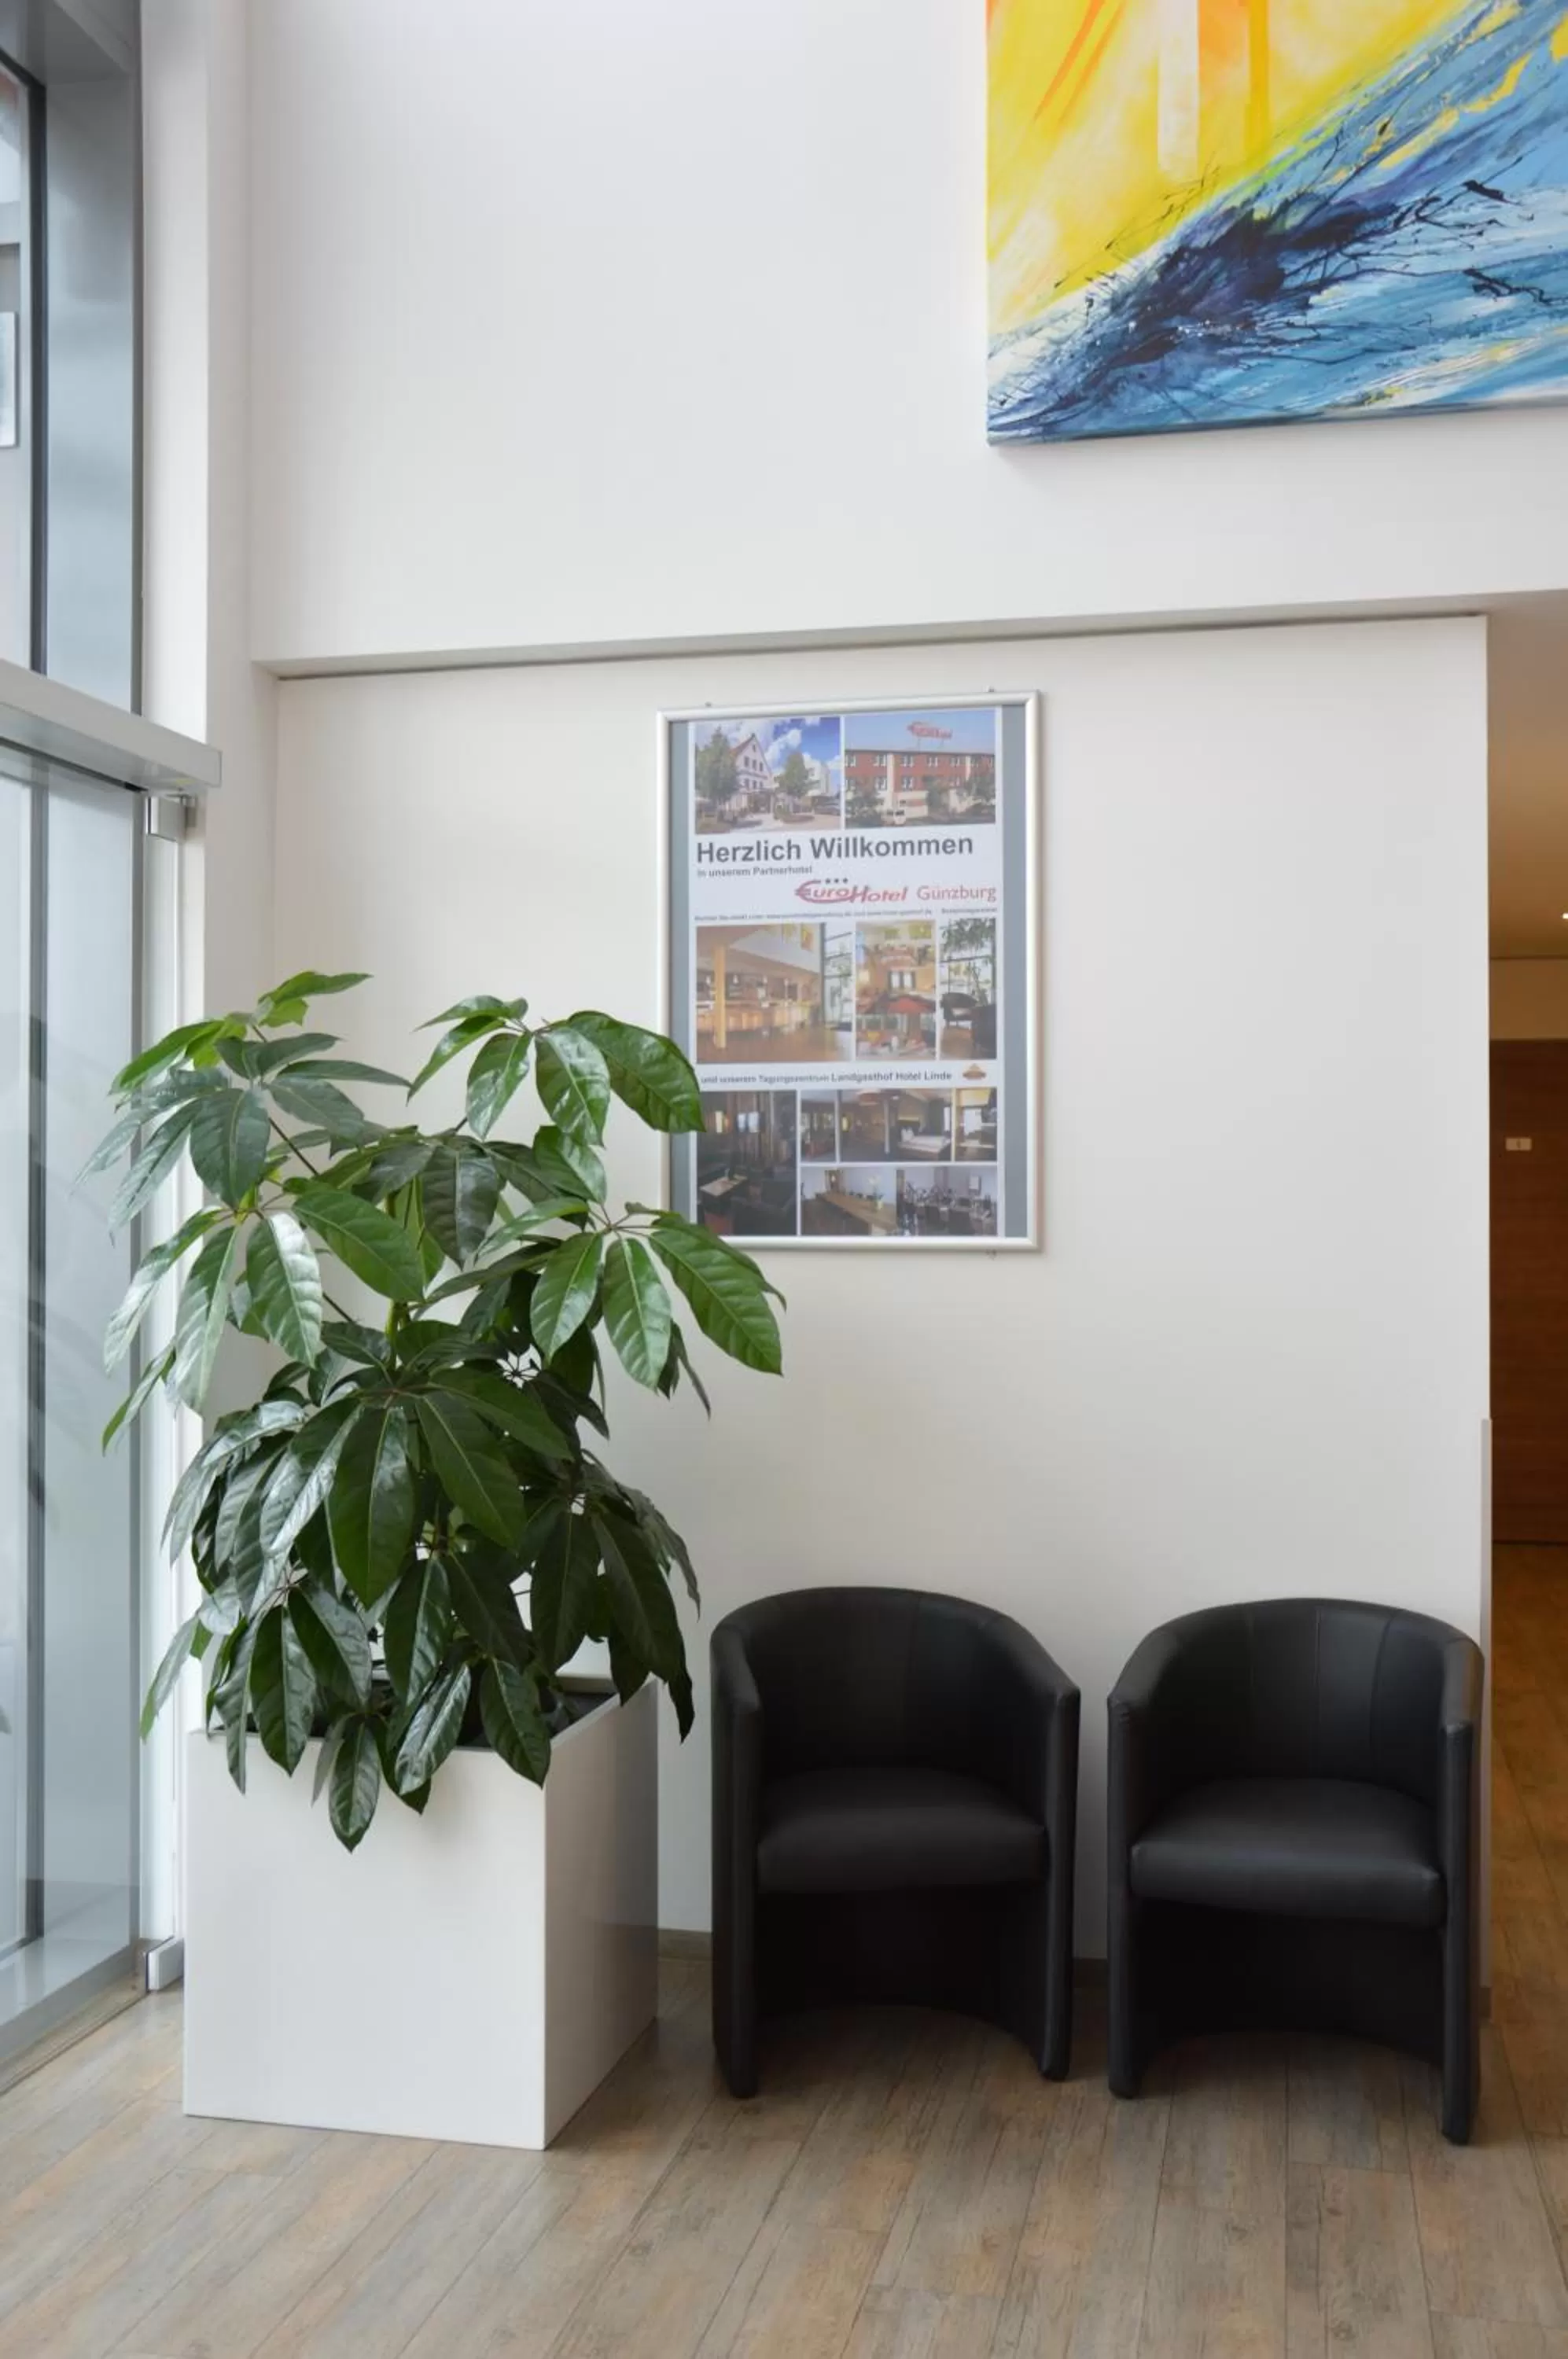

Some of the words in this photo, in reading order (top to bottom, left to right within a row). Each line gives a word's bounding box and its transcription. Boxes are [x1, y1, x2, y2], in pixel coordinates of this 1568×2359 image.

[697, 839, 801, 863] Herzlich
[810, 836, 973, 859] Willkommen
[709, 868, 751, 878] unserem
[753, 866, 812, 877] Partnerhotel
[917, 884, 997, 902] Günzburg
[831, 1071, 893, 1083] Landgasthof
[896, 1070, 922, 1080] Hotel
[924, 1069, 952, 1080] Linde
